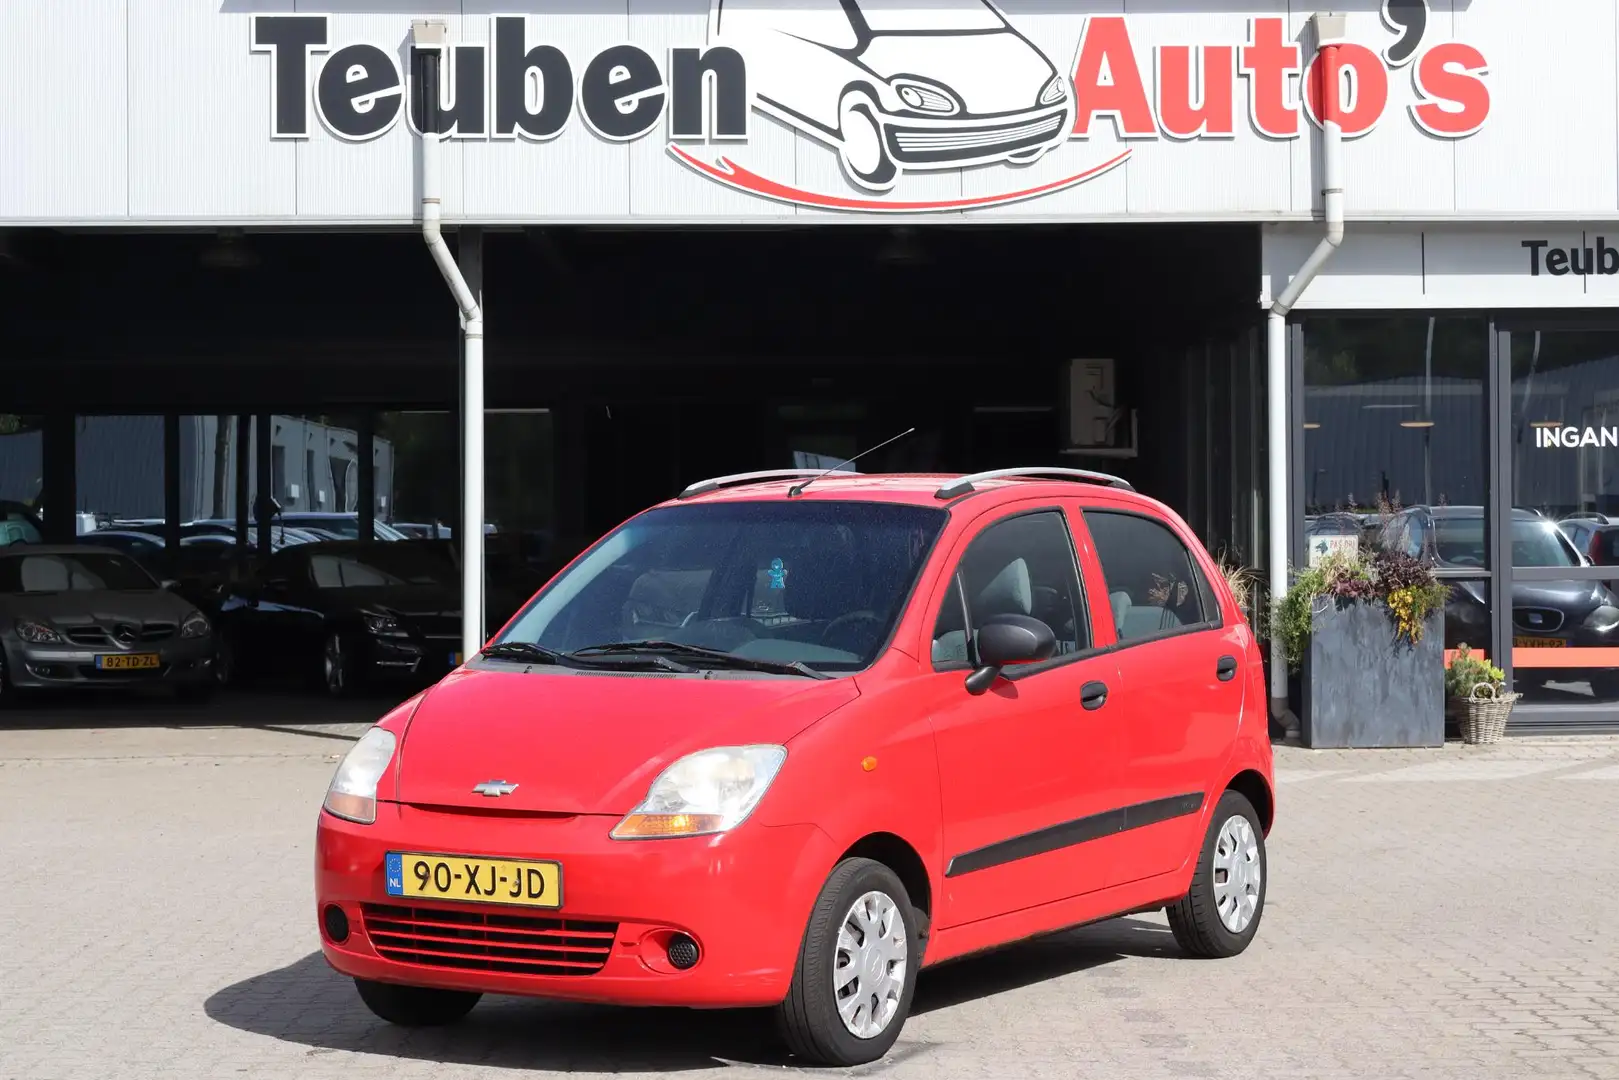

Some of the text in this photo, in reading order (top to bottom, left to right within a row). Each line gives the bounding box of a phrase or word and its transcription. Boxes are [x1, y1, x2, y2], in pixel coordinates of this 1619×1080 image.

[253, 0, 1491, 140] Teuben Auto's
[1521, 236, 1619, 276] Teub
[1535, 426, 1618, 448] INGAN
[106, 655, 156, 668] 82-TD-ZL
[413, 860, 546, 900] 90-XJ-JD
